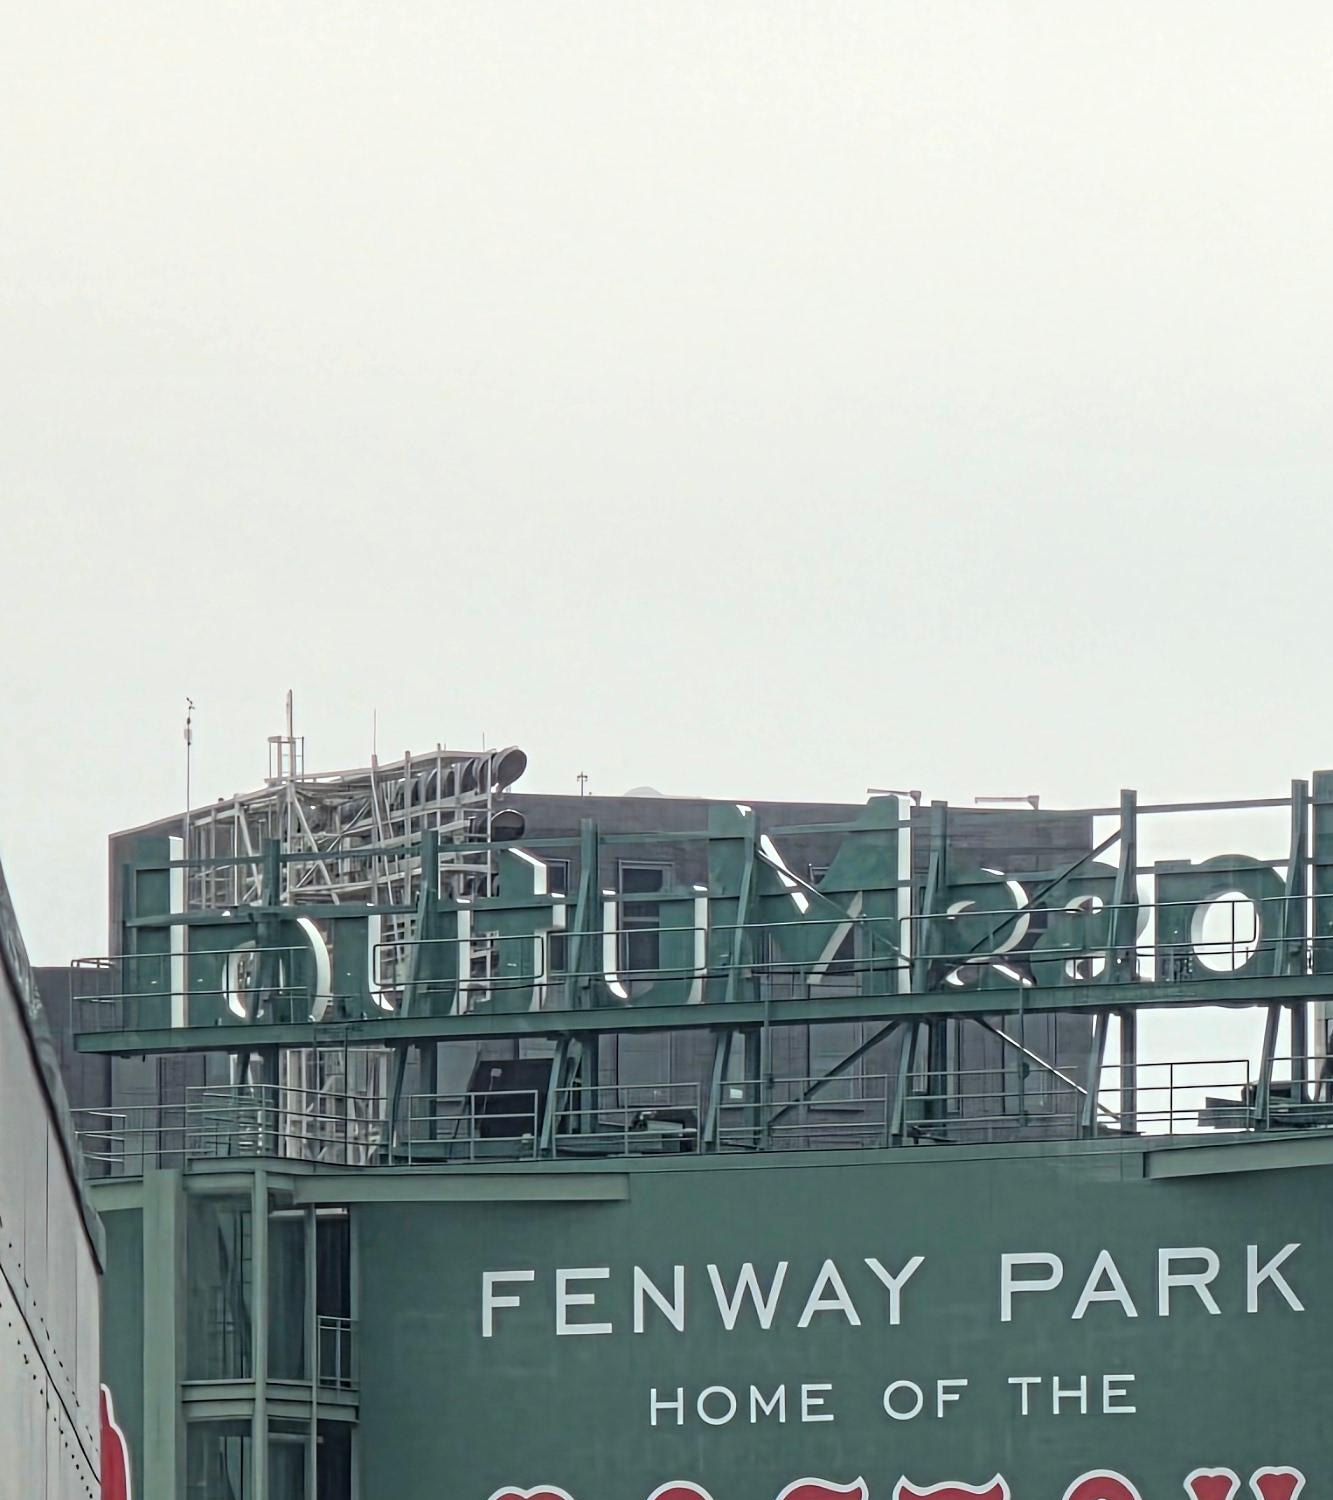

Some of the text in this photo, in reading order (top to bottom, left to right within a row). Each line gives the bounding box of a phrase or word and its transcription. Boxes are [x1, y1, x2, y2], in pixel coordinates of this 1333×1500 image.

[482, 1243, 1305, 1338] FENWAY PARK
[650, 1374, 1137, 1426] HOME OF THE
